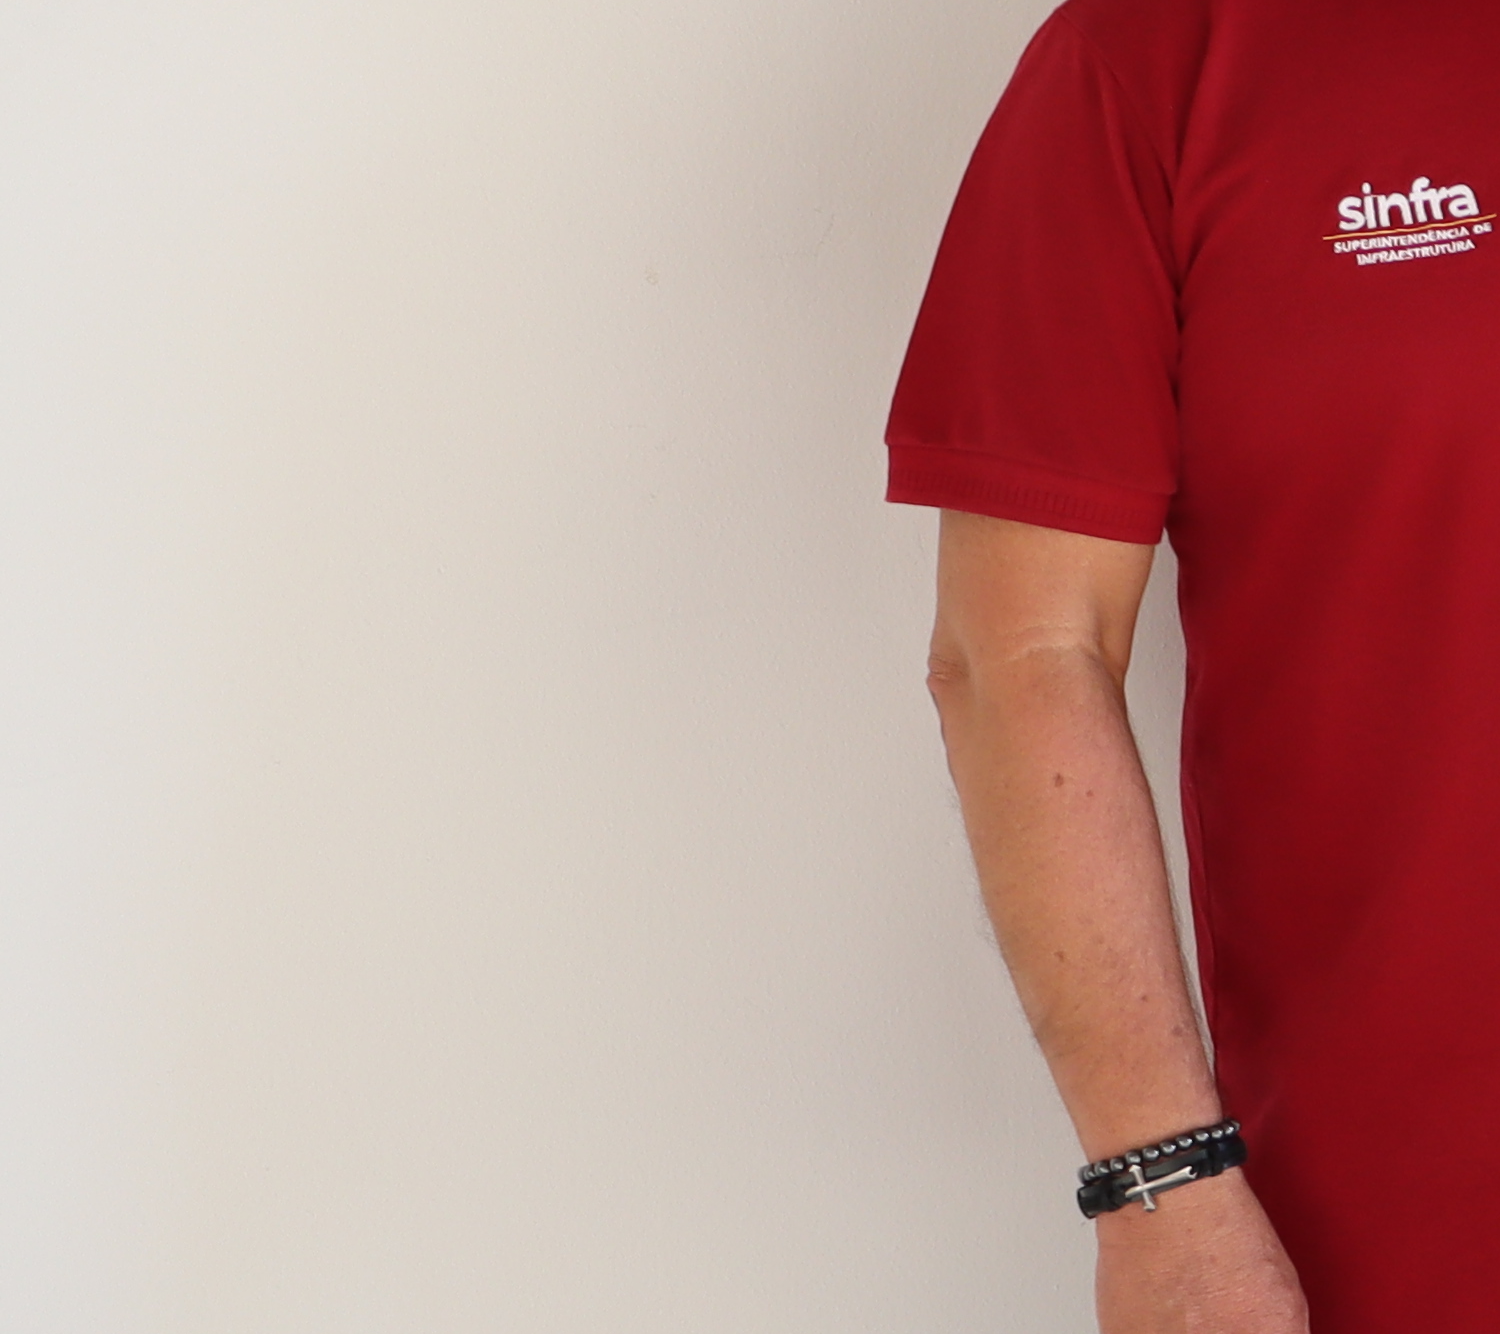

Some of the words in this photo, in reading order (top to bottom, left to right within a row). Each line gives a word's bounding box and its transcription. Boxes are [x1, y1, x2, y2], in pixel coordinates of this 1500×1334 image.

[1337, 176, 1480, 231] sinfra
[1333, 226, 1470, 254] SUPERINTENDÊNCIA
[1472, 222, 1493, 235] DE
[1356, 238, 1476, 266] INFRAESTRUTURA
